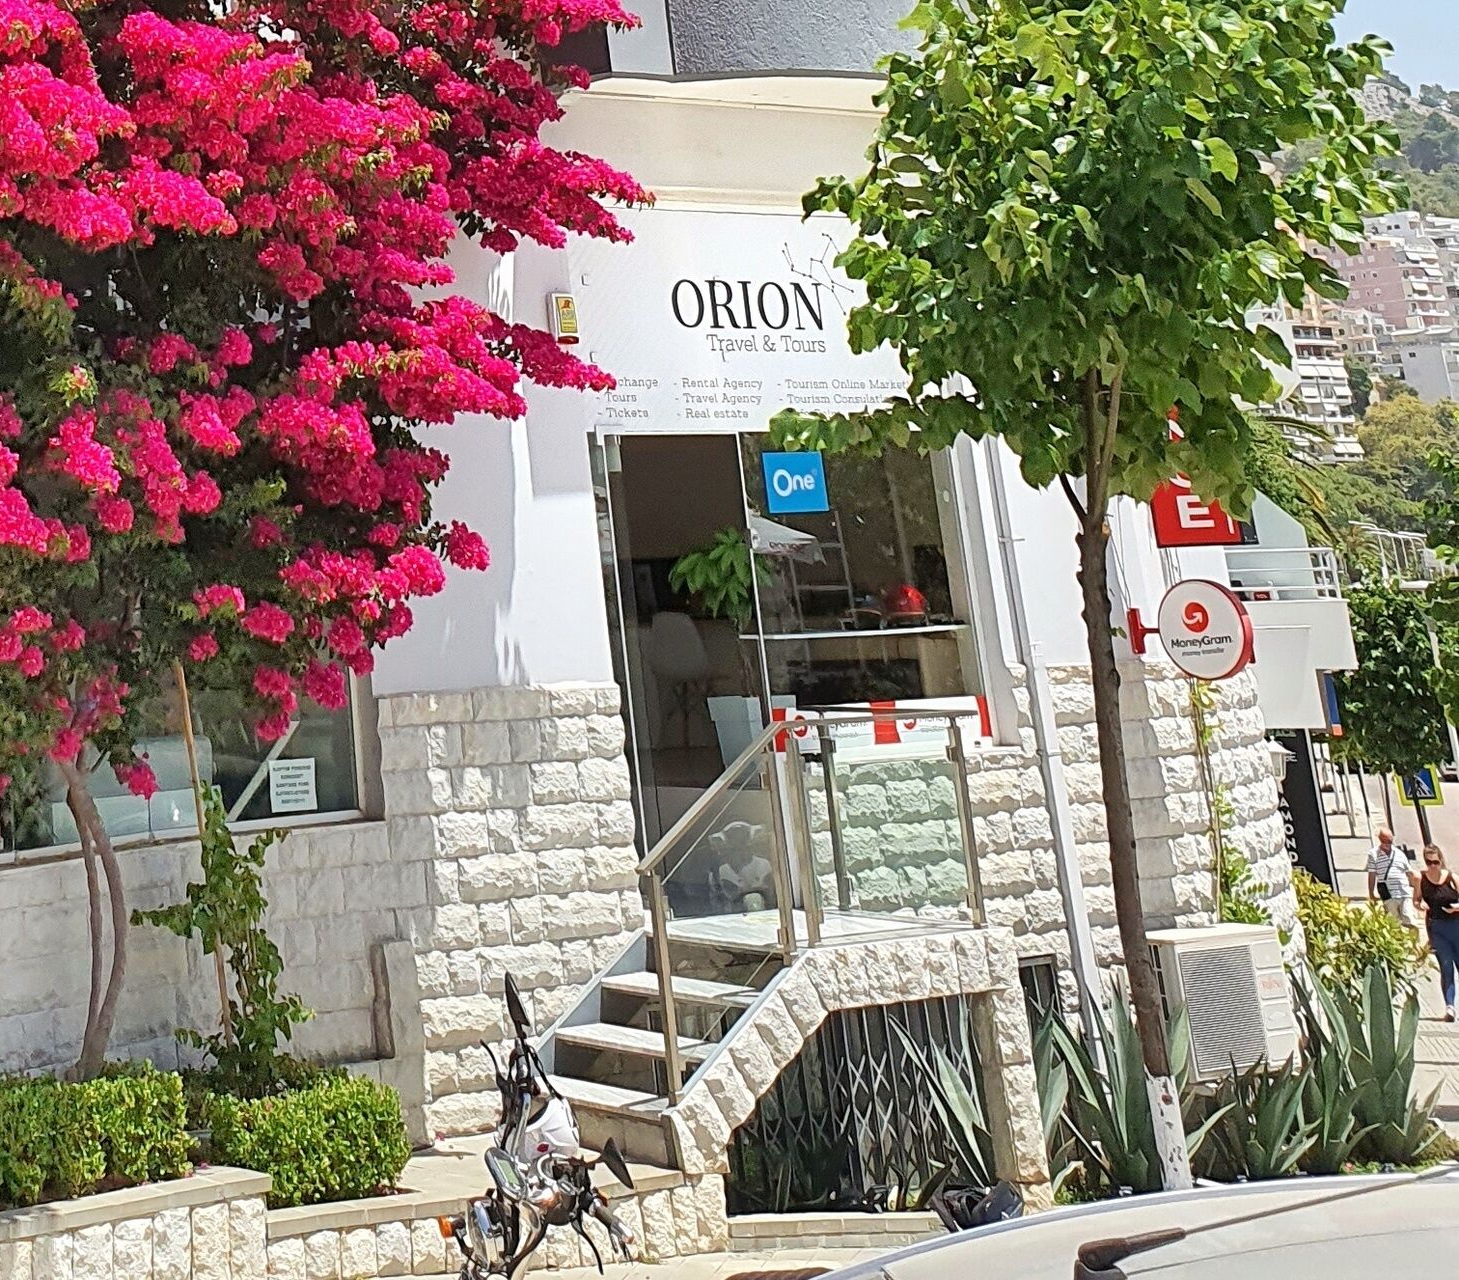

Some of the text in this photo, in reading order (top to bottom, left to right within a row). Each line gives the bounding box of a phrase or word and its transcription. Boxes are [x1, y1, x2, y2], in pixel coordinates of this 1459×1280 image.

[671, 278, 824, 331] ORION
[706, 333, 827, 353] Travel & Tours
[618, 376, 659, 389] change
[682, 377, 763, 391] Rental Agency
[785, 378, 908, 391] Tourism Online Market
[605, 391, 638, 404] Tours
[683, 392, 762, 406] Travel Agency
[787, 393, 831, 405] Tourism
[606, 406, 649, 419] Tickets
[685, 407, 749, 420] Real estate
[772, 468, 815, 497] One
[1170, 635, 1232, 649] MoneyGram
[1278, 797, 1300, 864] AMOND
